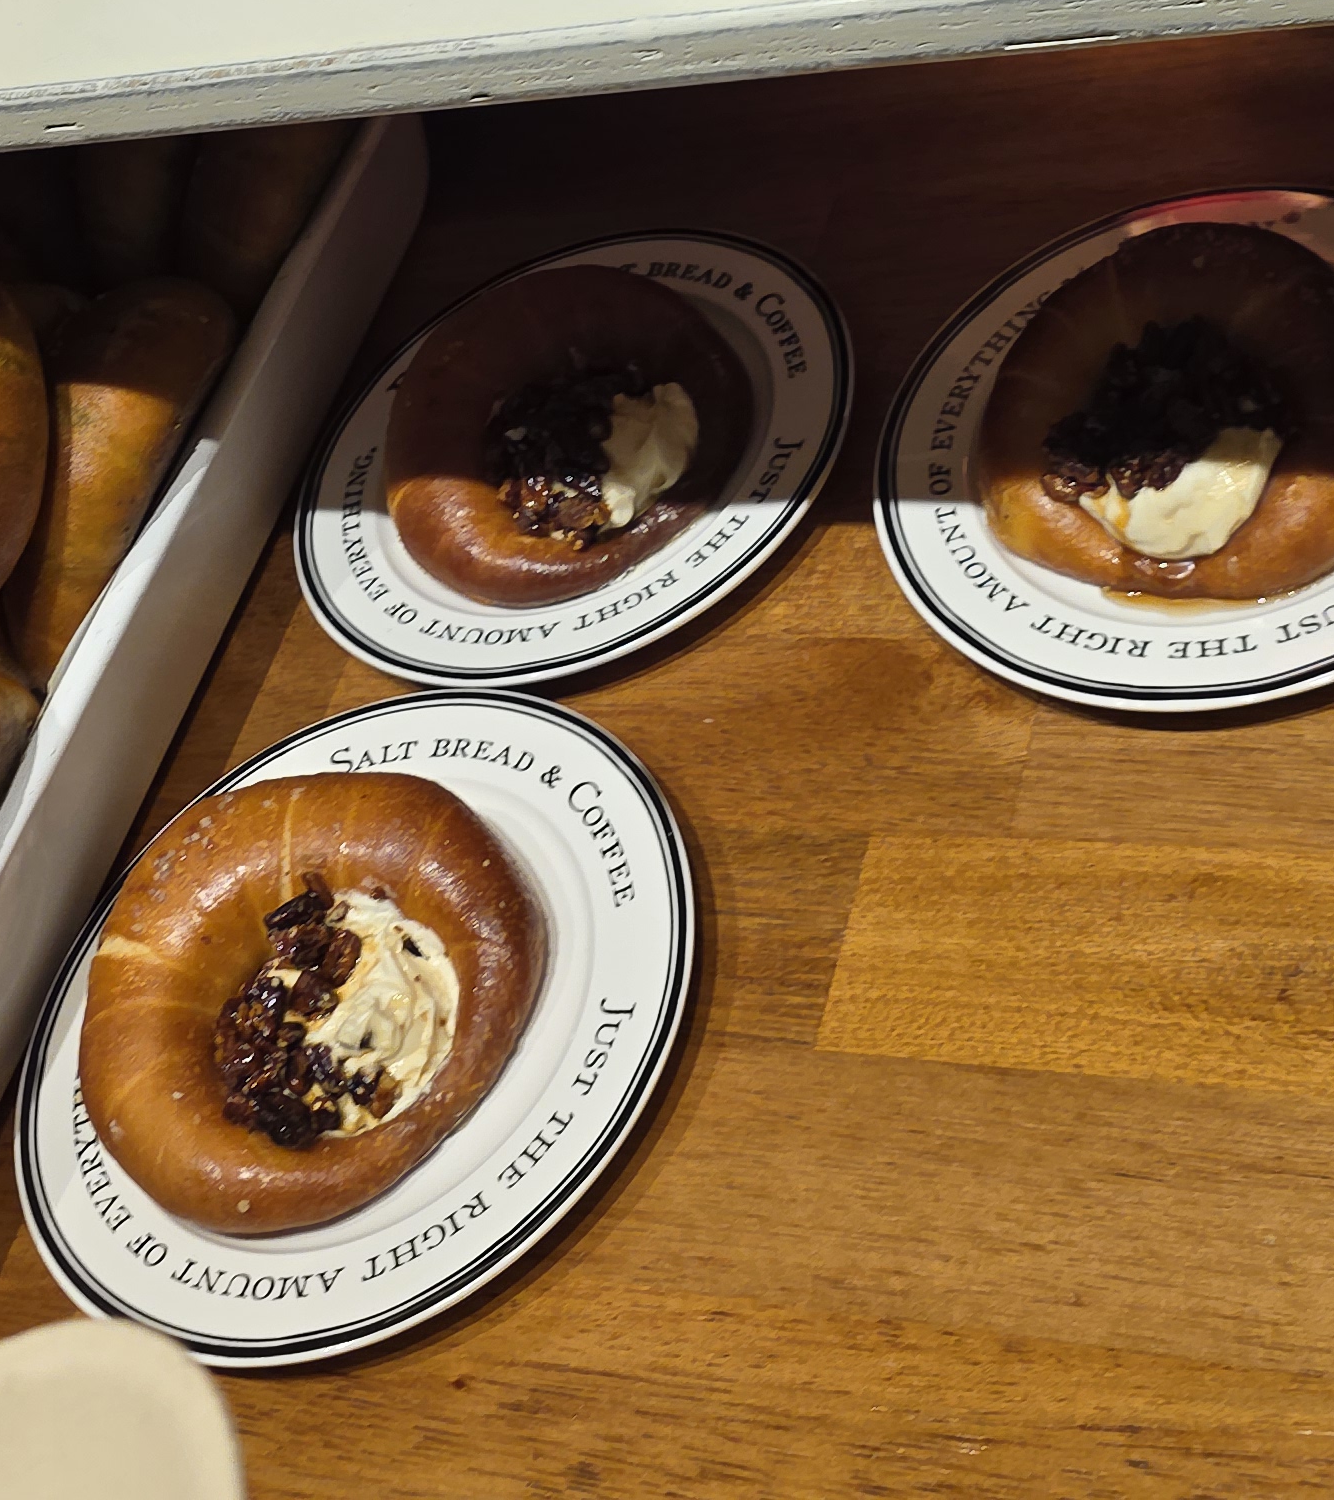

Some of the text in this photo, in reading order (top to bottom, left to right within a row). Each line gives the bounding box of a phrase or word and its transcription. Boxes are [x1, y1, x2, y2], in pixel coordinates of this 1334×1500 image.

[647, 262, 733, 288] BREAD
[735, 282, 756, 300] &
[928, 461, 953, 496] OF
[686, 513, 749, 568] THE
[934, 506, 1030, 613] AMOUNT
[384, 602, 418, 628] OF
[573, 570, 679, 632] RIGHT
[420, 619, 560, 645] AMOUNT
[1029, 616, 1152, 658] RIGHT
[1167, 635, 1259, 660] THE
[430, 738, 535, 772] BREAD
[541, 764, 563, 789] &
[72, 1076, 134, 1233] EVERYT
[498, 1110, 575, 1192] THE
[126, 1232, 169, 1269] OF
[362, 1190, 492, 1284] RIGHT
[171, 1258, 345, 1301] AMOUNT
